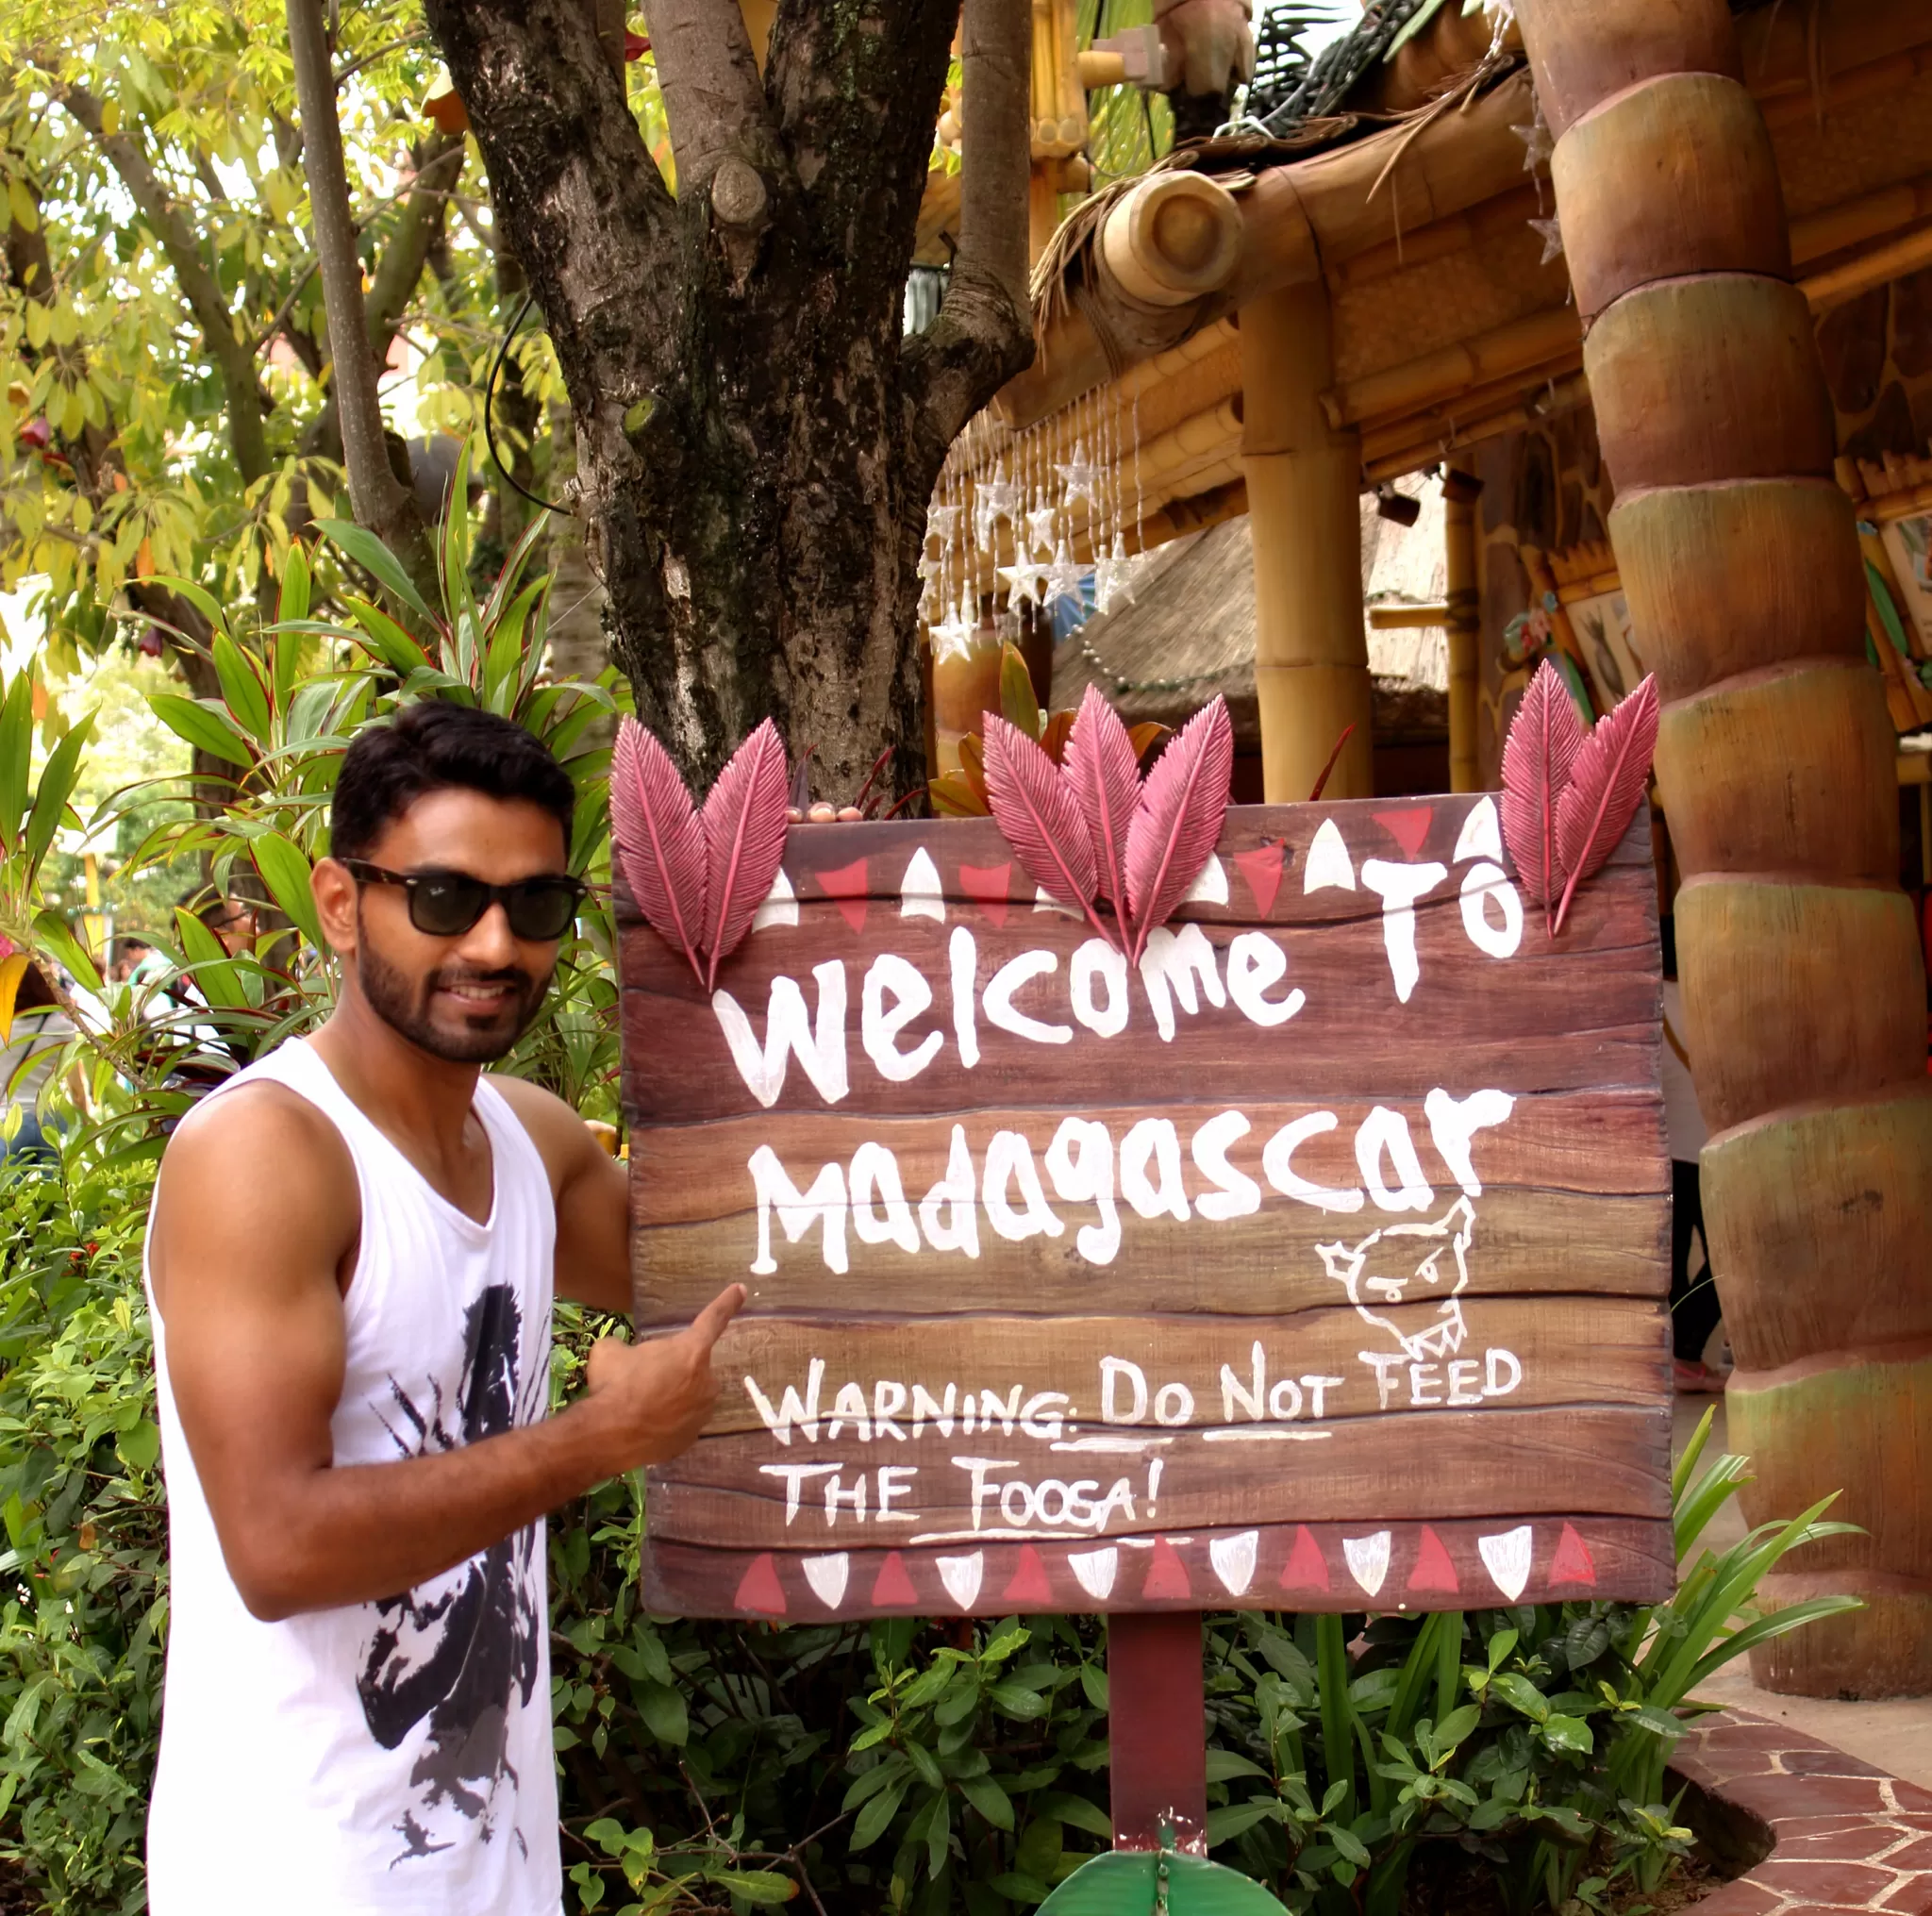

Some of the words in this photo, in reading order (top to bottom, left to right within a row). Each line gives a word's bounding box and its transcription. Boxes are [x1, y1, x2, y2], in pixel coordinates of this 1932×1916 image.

[712, 922, 1306, 1108] Welcome
[747, 1088, 1517, 1275] Madagascar
[744, 1358, 1077, 1445] WARNING:
[1357, 1347, 1522, 1409] FEED
[759, 1462, 921, 1526] THE
[951, 1457, 1164, 1533] FOOSA!
